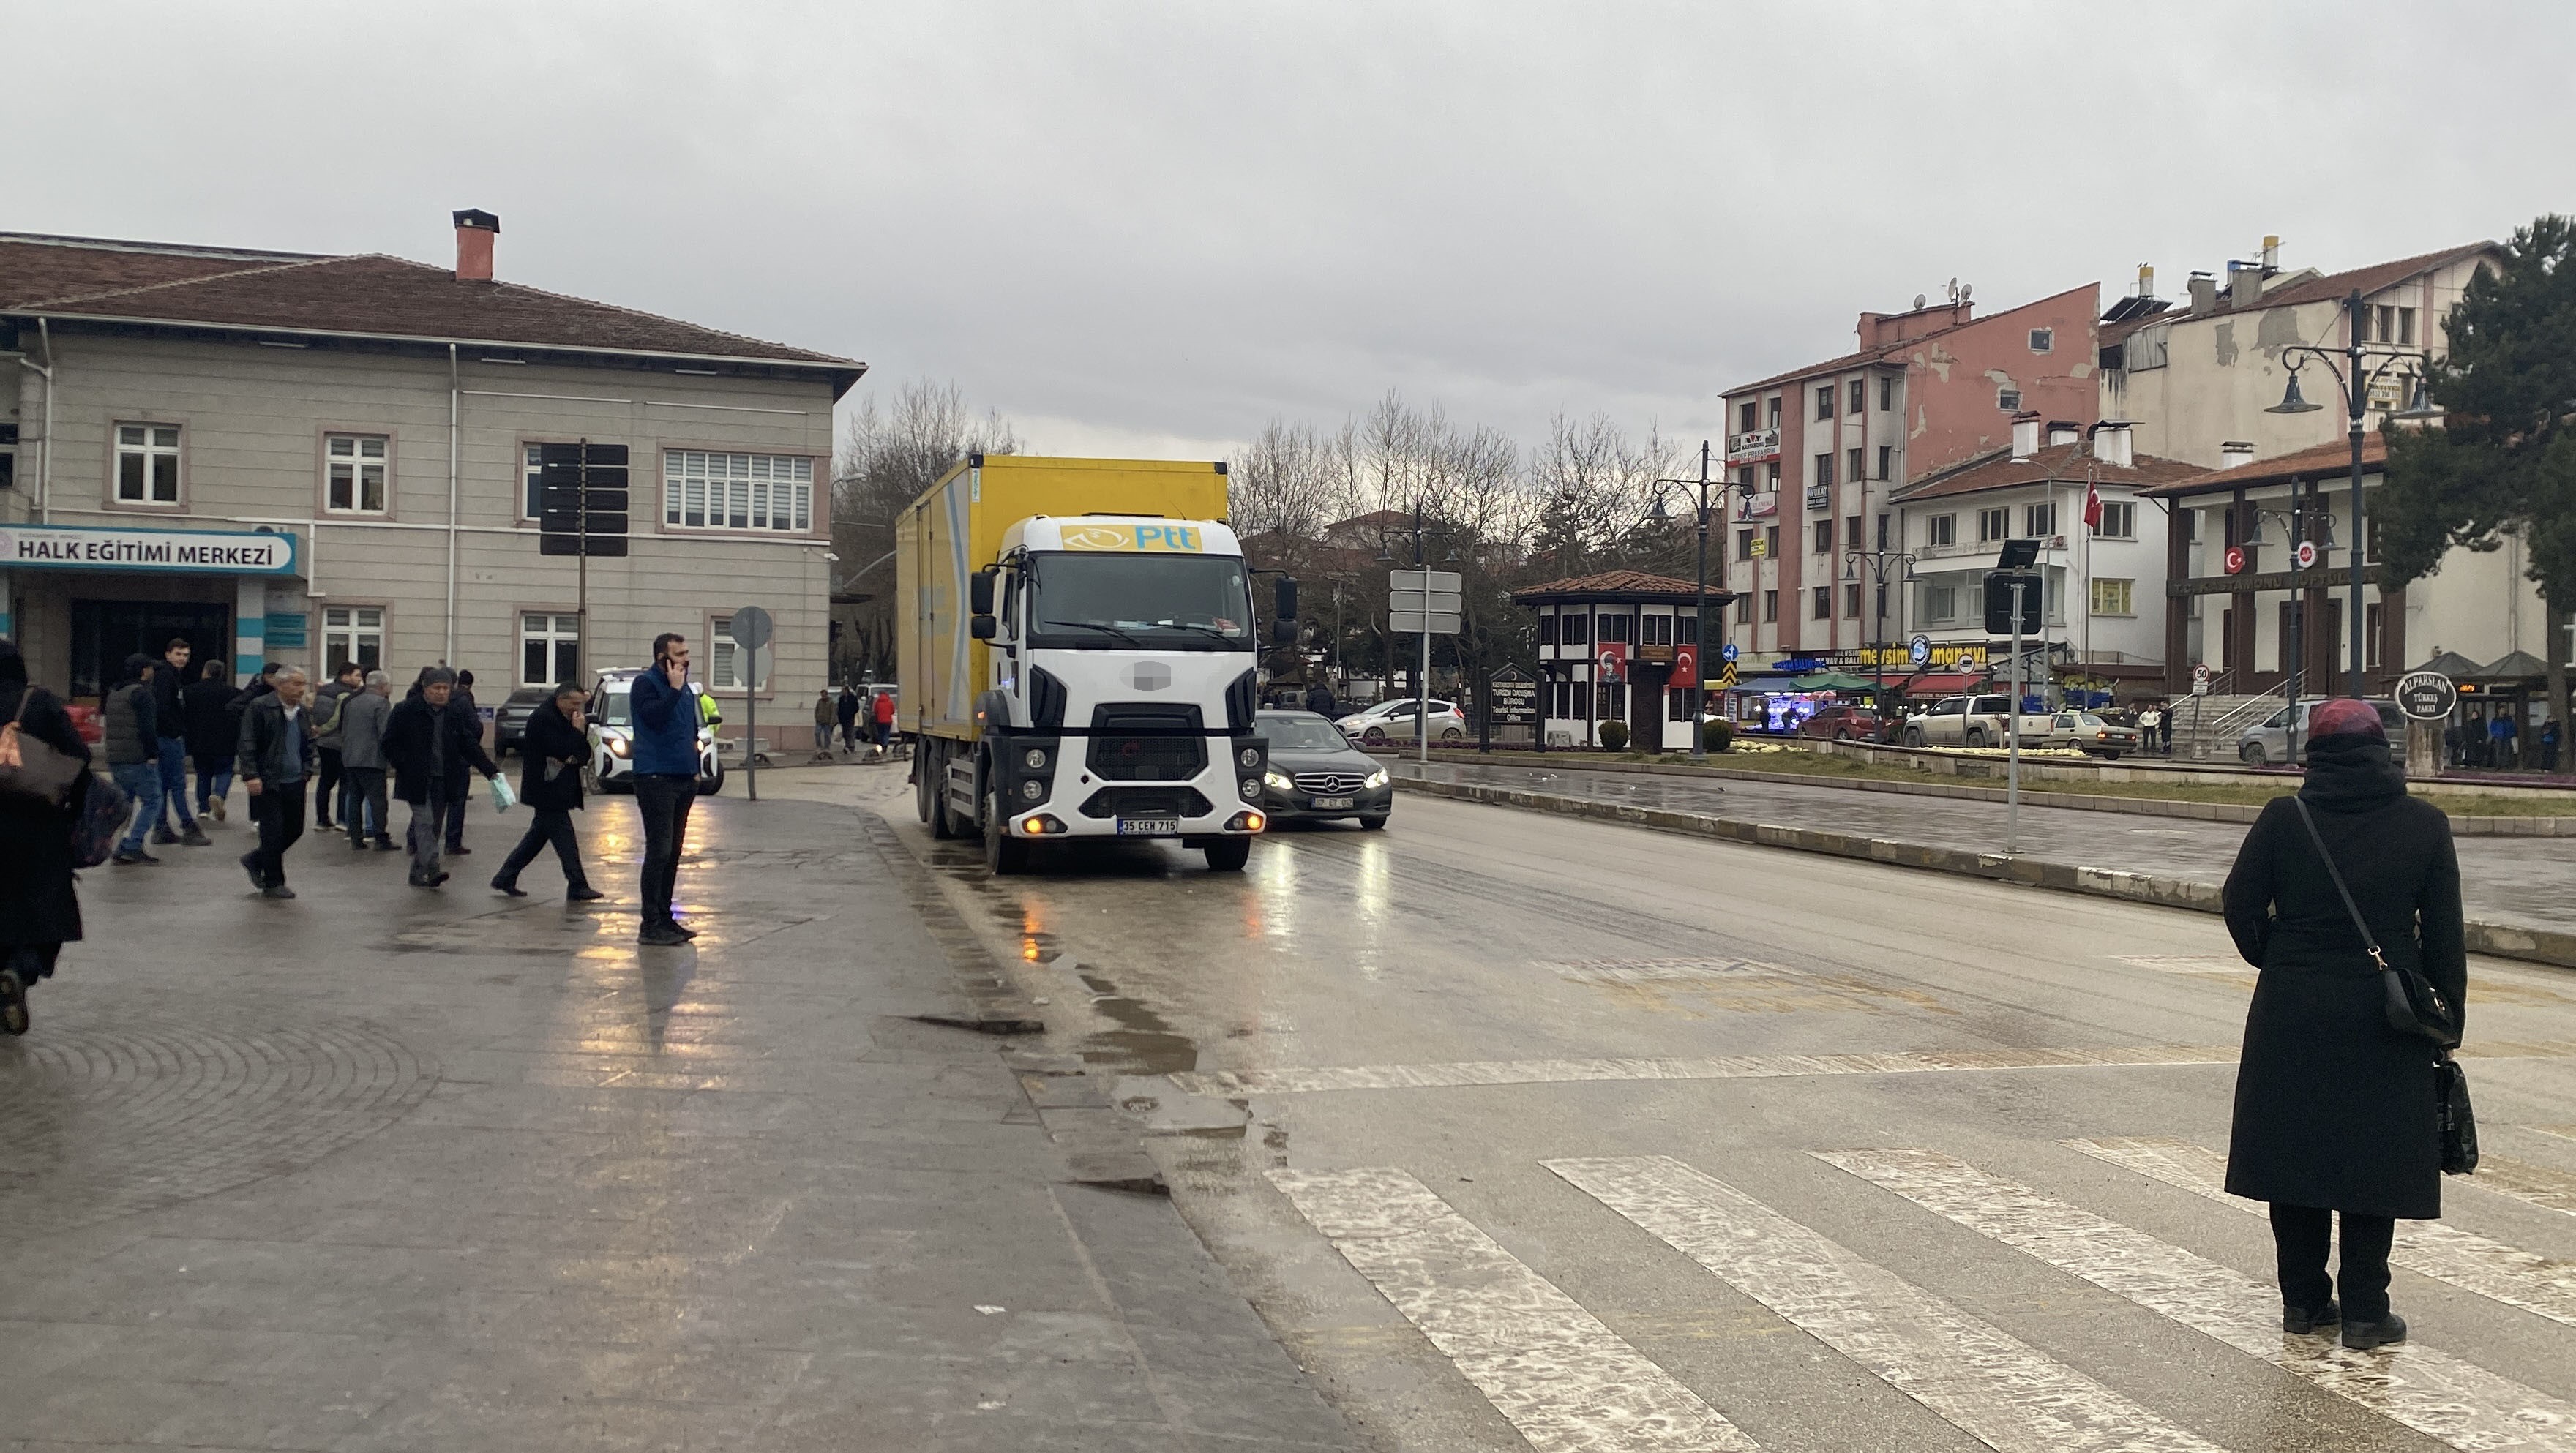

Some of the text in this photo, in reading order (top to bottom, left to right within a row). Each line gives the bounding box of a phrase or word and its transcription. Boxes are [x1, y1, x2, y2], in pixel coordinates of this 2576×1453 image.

[1808, 486, 1827, 498] AVUKAT
[1134, 525, 1197, 549] Ptt
[18, 540, 272, 565] HALK EĞİTİMİ MERKEZİ
[2196, 669, 2207, 678] 50
[2405, 673, 2448, 694] ALPARSLAN
[2414, 692, 2438, 704] TÜRKEŞ
[2416, 705, 2435, 713] PARKI
[1123, 819, 1176, 831] 35 CEH 715
